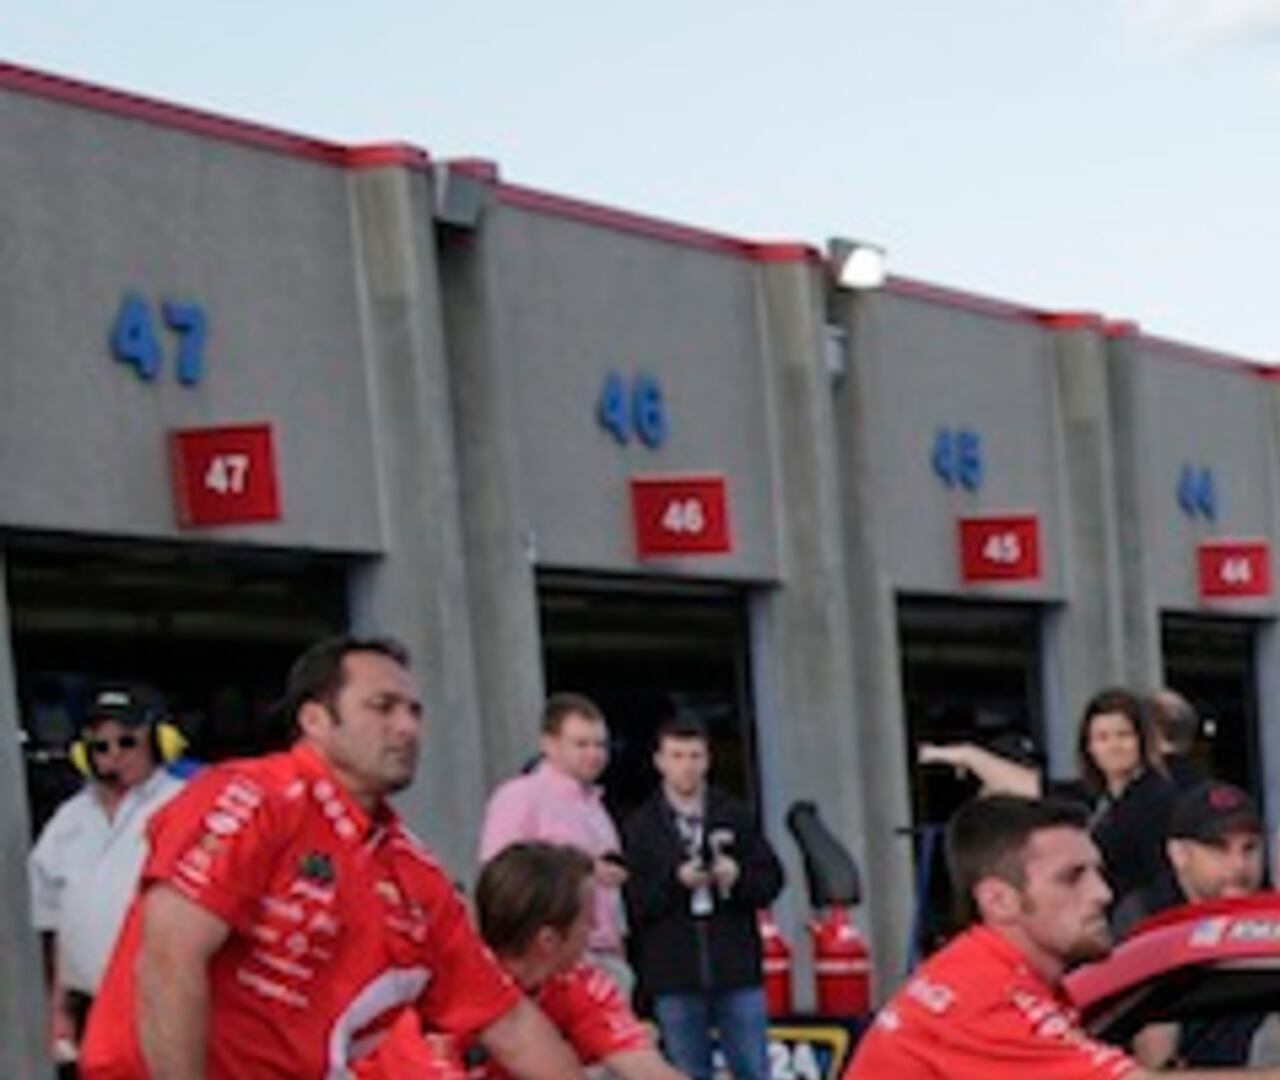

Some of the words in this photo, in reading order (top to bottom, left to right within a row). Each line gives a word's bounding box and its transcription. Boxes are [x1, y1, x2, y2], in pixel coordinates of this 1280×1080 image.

[108, 290, 209, 388] 47
[598, 370, 669, 450] 46
[205, 454, 250, 495] 47
[663, 499, 704, 533] 46
[982, 531, 1022, 564] 45
[1219, 556, 1251, 583] 44
